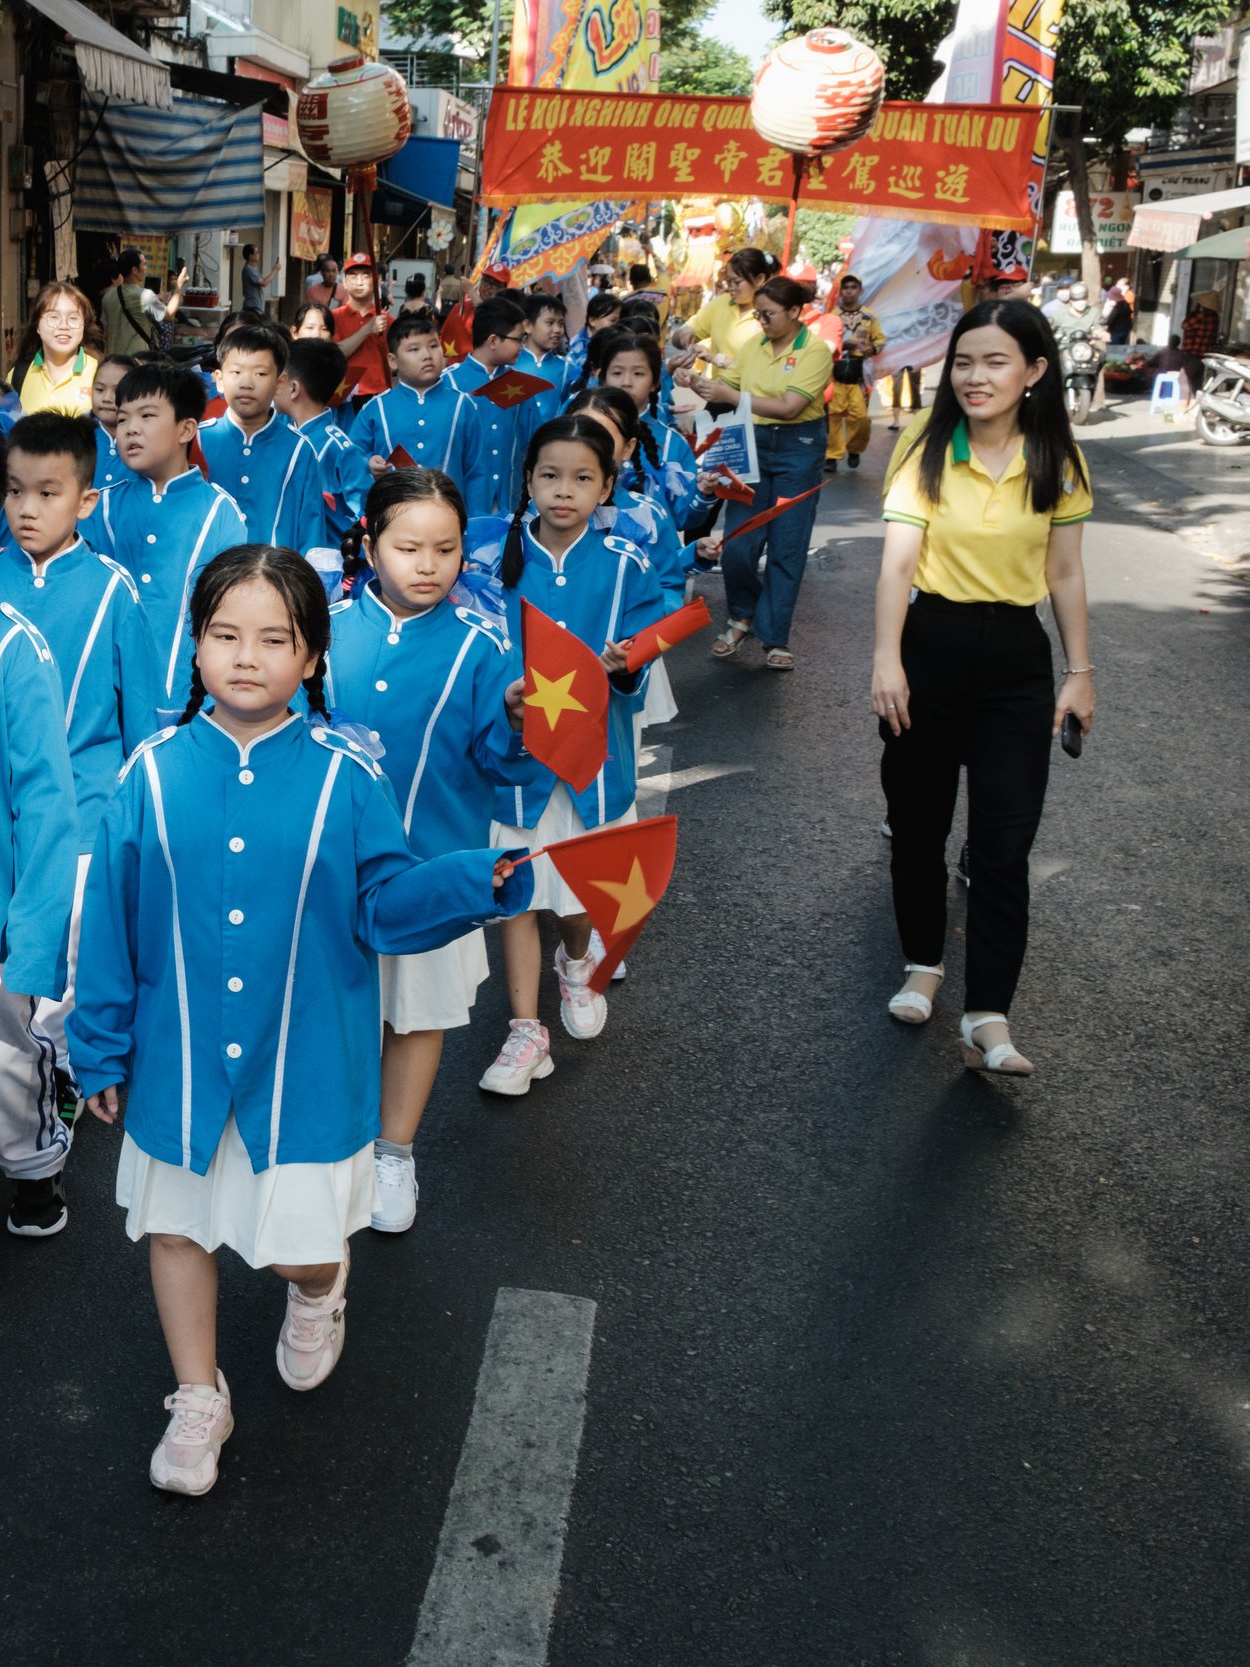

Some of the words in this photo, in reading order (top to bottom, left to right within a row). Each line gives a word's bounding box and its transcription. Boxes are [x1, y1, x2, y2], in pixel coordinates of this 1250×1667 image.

[568, 97, 653, 128] NGHINH
[653, 99, 700, 129] ÔNG
[986, 116, 1022, 152] DU
